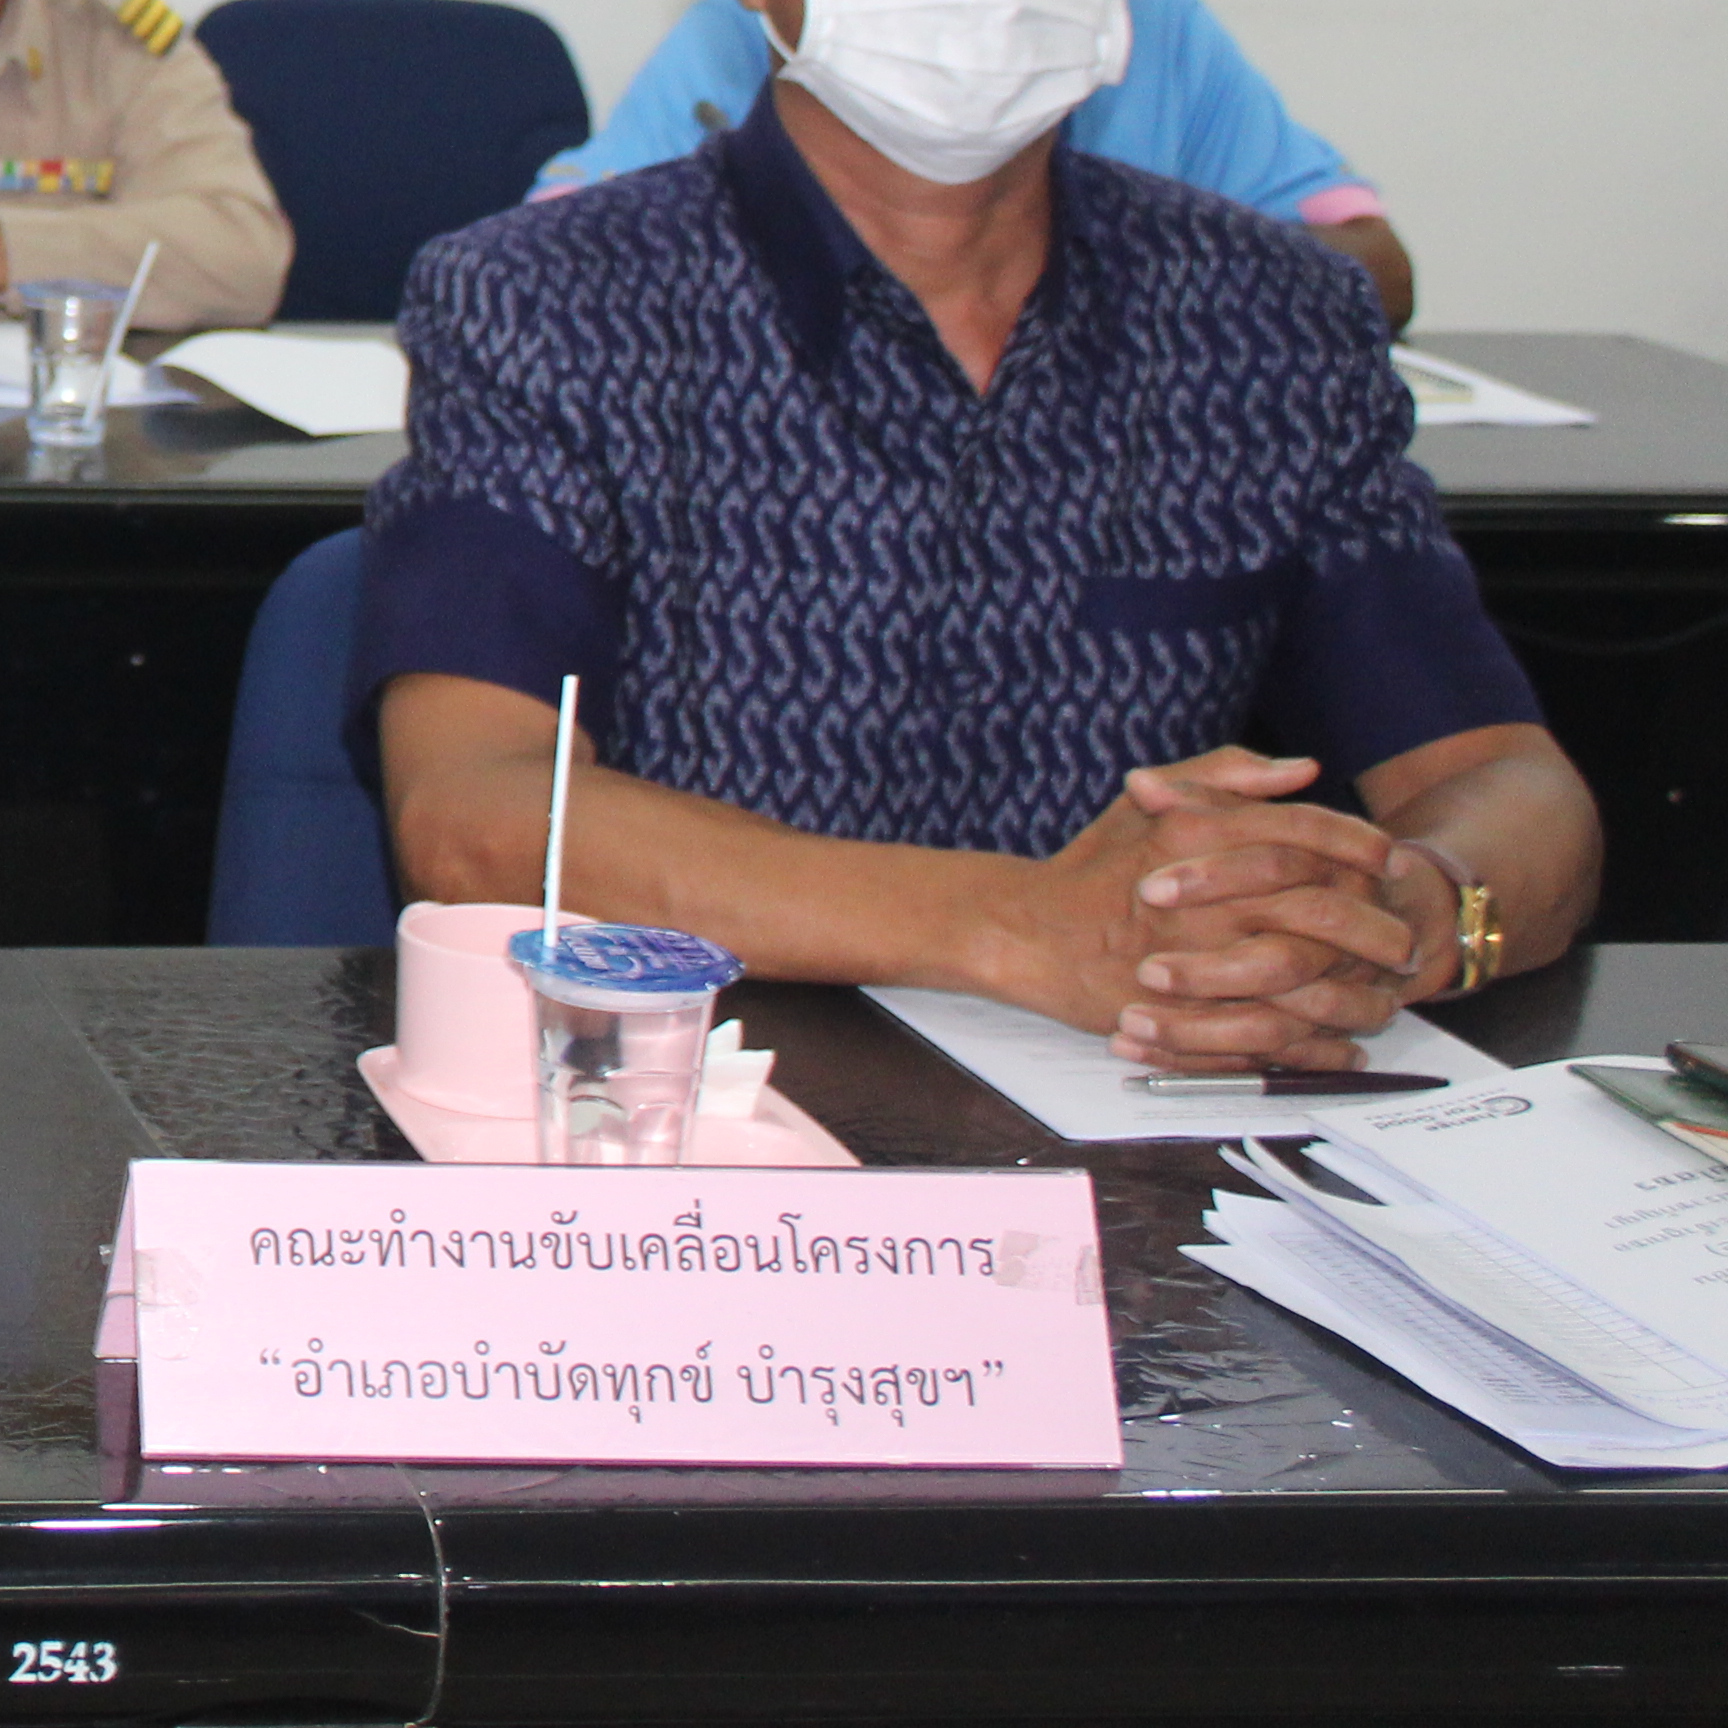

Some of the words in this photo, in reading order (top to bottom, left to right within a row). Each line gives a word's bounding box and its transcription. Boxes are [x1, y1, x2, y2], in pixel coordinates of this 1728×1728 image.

[247, 1199, 997, 1278] คณะทำงานขับเคลื่อนโครงการ
[258, 1338, 717, 1425] “อำเภอบำบัดทุกข์
[738, 1346, 1007, 1428] บำรุงสุขฯ”
[7, 1641, 119, 1683] 2543
